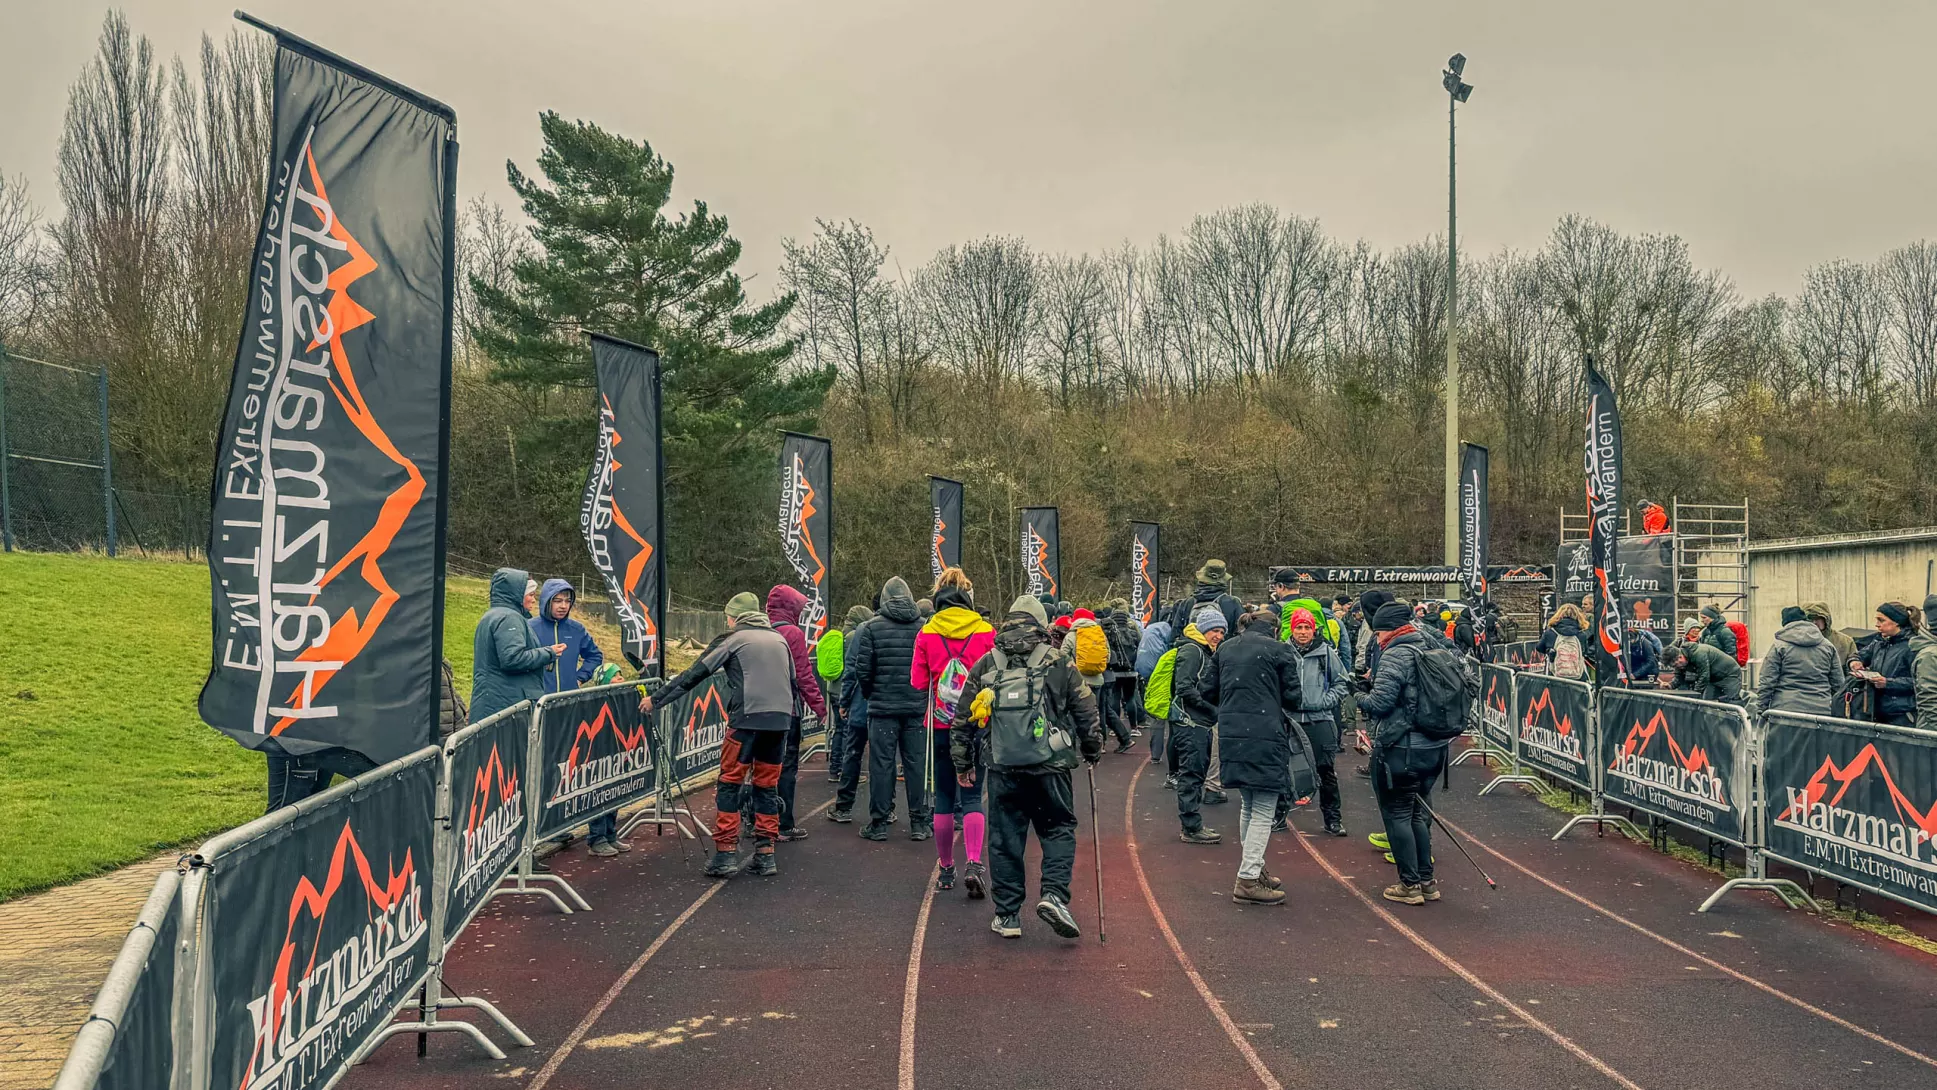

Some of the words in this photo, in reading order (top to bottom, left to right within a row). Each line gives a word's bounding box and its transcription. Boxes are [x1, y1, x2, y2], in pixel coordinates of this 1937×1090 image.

[1327, 569, 1370, 582] E.M.T.I
[1373, 568, 1465, 582] Extremwande
[556, 736, 651, 798] Harzmarsch
[1614, 743, 1723, 803] Harzmarsch
[1804, 834, 1847, 867] E.M.T.I
[246, 870, 422, 1090] Harzmarsch
